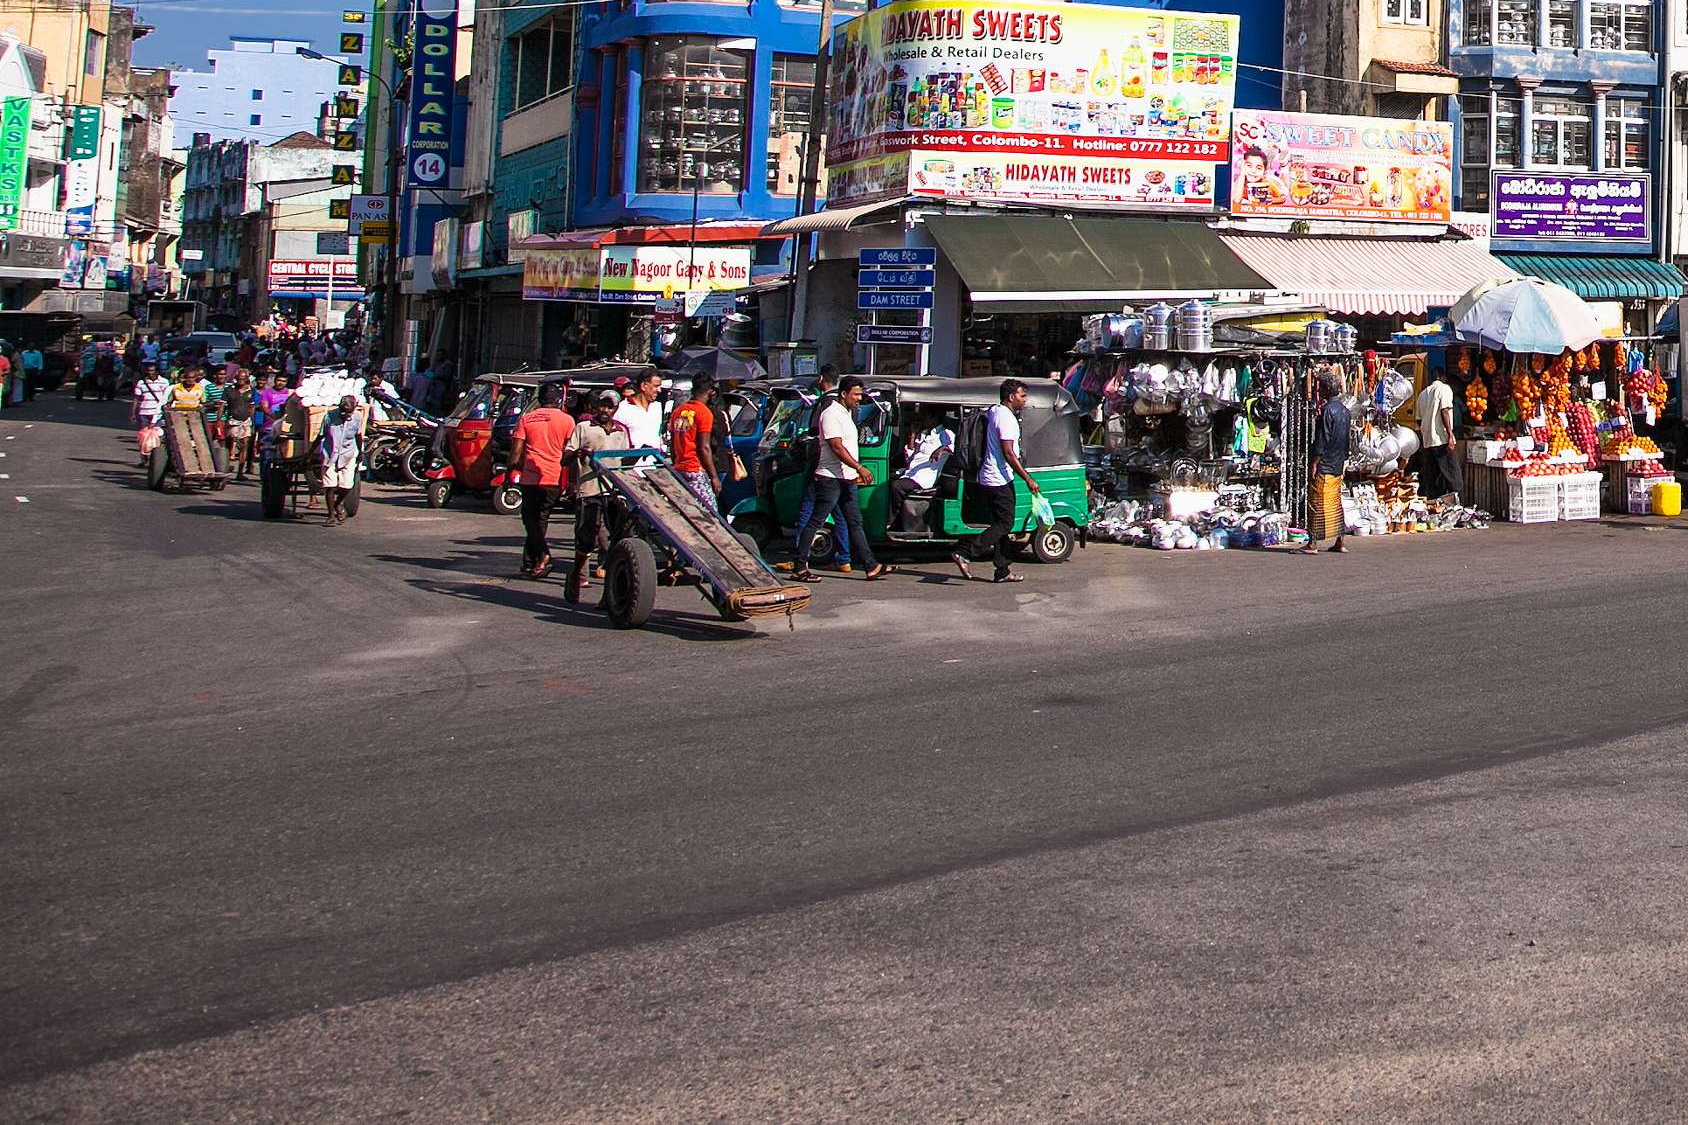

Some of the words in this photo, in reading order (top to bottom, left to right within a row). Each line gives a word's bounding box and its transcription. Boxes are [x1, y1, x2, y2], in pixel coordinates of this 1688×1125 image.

[972, 9, 1063, 44] SWEETS
[931, 46, 942, 59] &
[948, 46, 987, 59] Retail
[993, 48, 1044, 61] Dealers
[419, 24, 449, 135] DOLLAR
[1240, 123, 1259, 140] SC
[1265, 123, 1356, 148] SWEET
[1362, 127, 1448, 154] CANDY
[411, 140, 449, 150] CORPORATION
[922, 134, 967, 147] Street,
[972, 134, 1065, 150] Colombo-11.
[1073, 138, 1127, 151] Hotline:
[1129, 142, 1163, 153] 0777
[1166, 142, 1190, 154] 122
[1193, 143, 1217, 155] 182
[418, 159, 441, 175] 14
[1005, 163, 1077, 183] HIDAYATH
[1082, 166, 1131, 185] SWEETS
[352, 212, 371, 220] PAN
[271, 263, 307, 274] CENTRAL
[308, 263, 333, 274] CYCL
[604, 257, 628, 278] New
[631, 258, 671, 283] Nagoor
[708, 261, 716, 279] &
[720, 261, 747, 279] Sons
[870, 295, 889, 305] DAM
[890, 295, 920, 305] STREET
